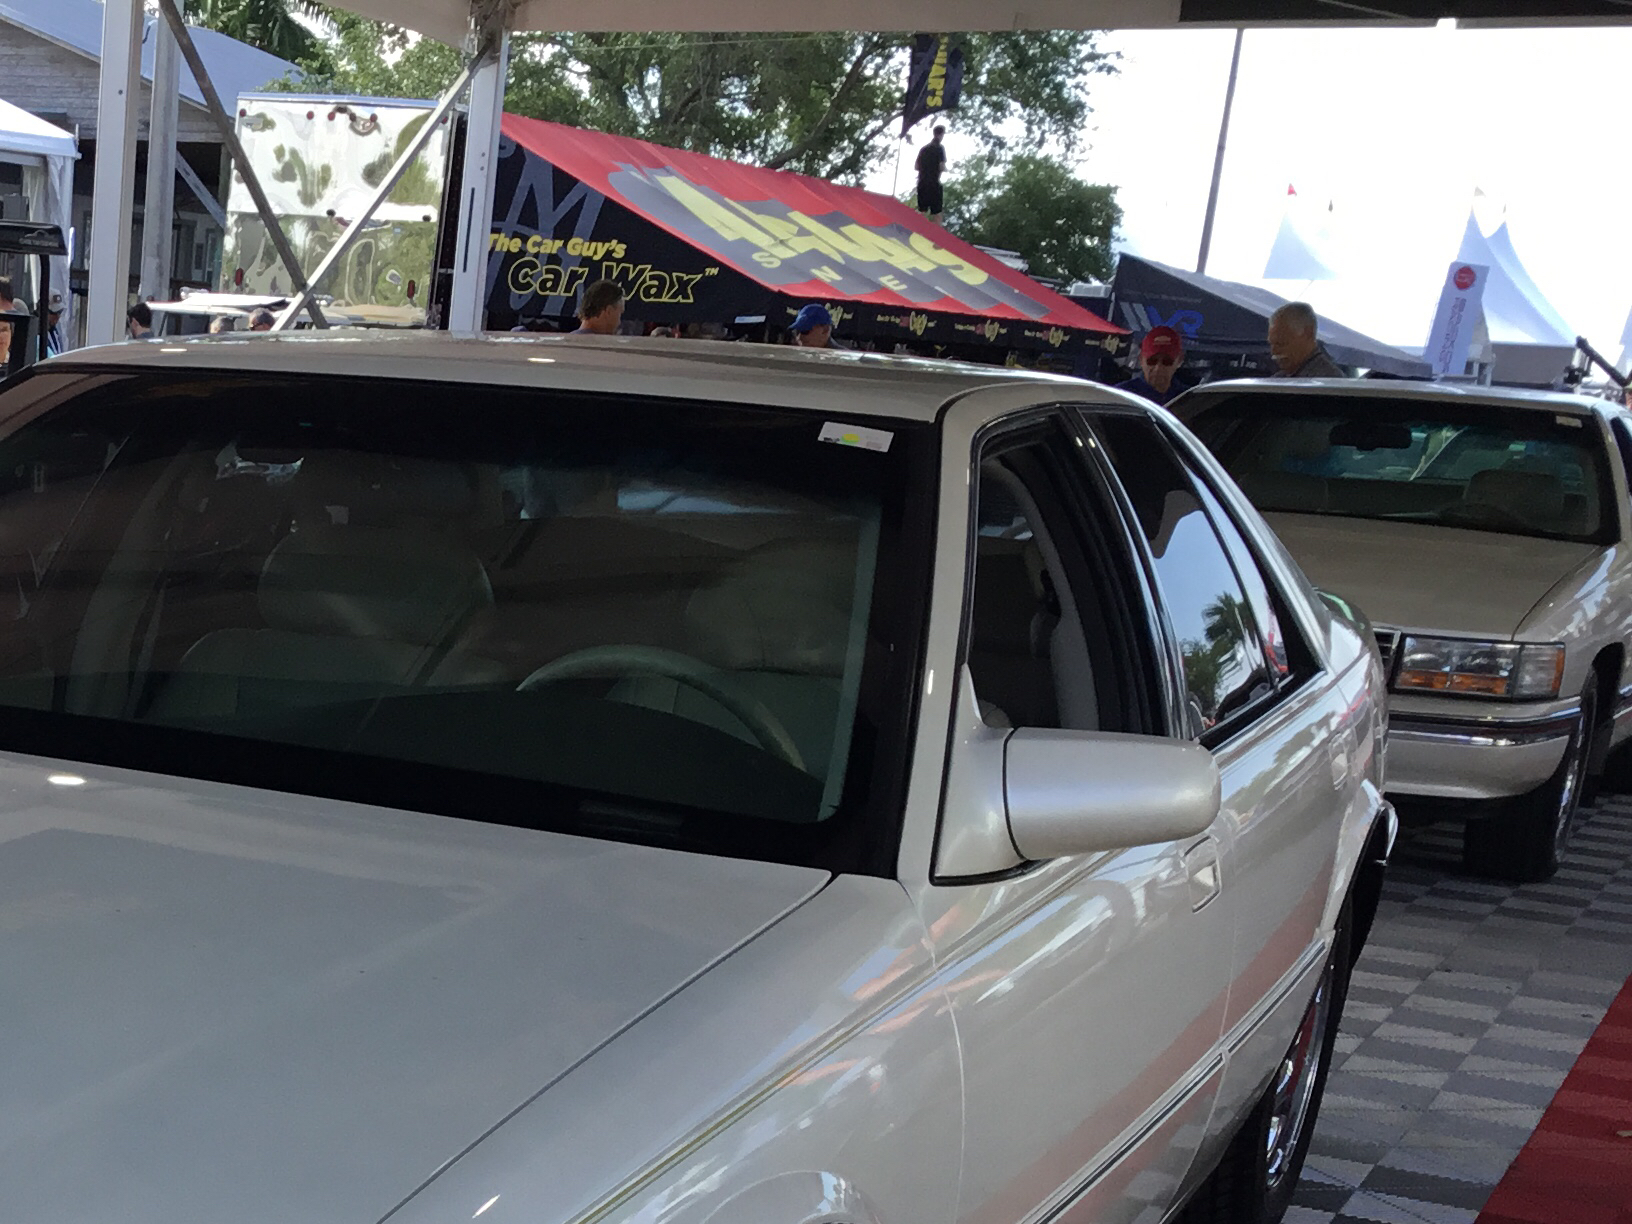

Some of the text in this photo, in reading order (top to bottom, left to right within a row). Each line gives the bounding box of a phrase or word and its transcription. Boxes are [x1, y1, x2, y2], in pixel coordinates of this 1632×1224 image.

[489, 233, 627, 261] The Car Guy's
[508, 256, 589, 297] Car
